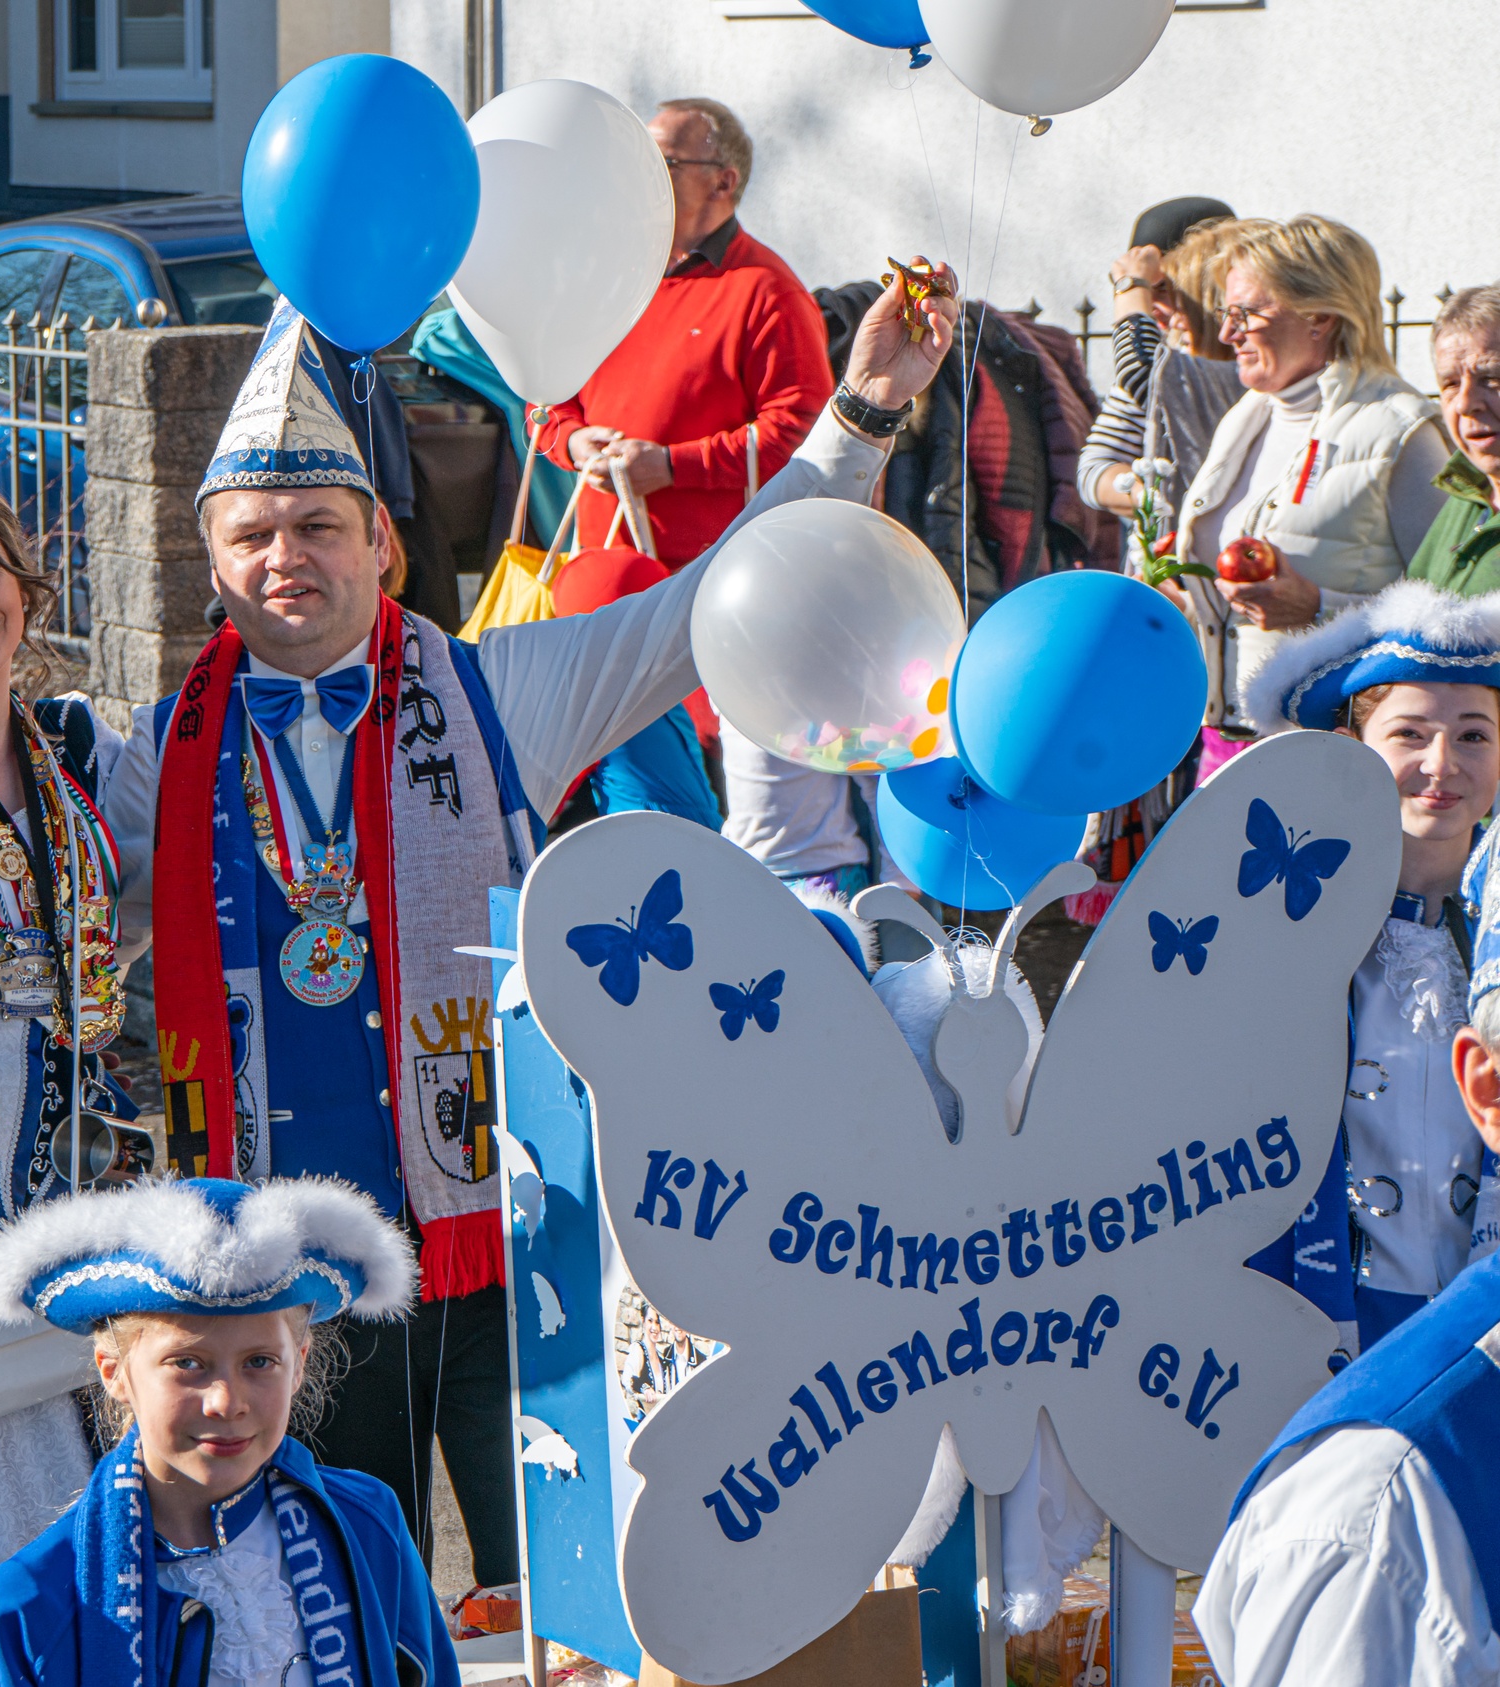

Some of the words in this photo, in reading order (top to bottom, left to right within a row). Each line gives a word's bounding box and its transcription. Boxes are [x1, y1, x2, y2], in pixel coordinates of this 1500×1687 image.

[328, 933, 341, 942] 50
[420, 1061, 439, 1084] 11
[634, 1150, 749, 1241] KV
[769, 1115, 1301, 1295] Schmetterling
[703, 1294, 1121, 1543] Wallendorf
[1139, 1343, 1240, 1440] e.V.
